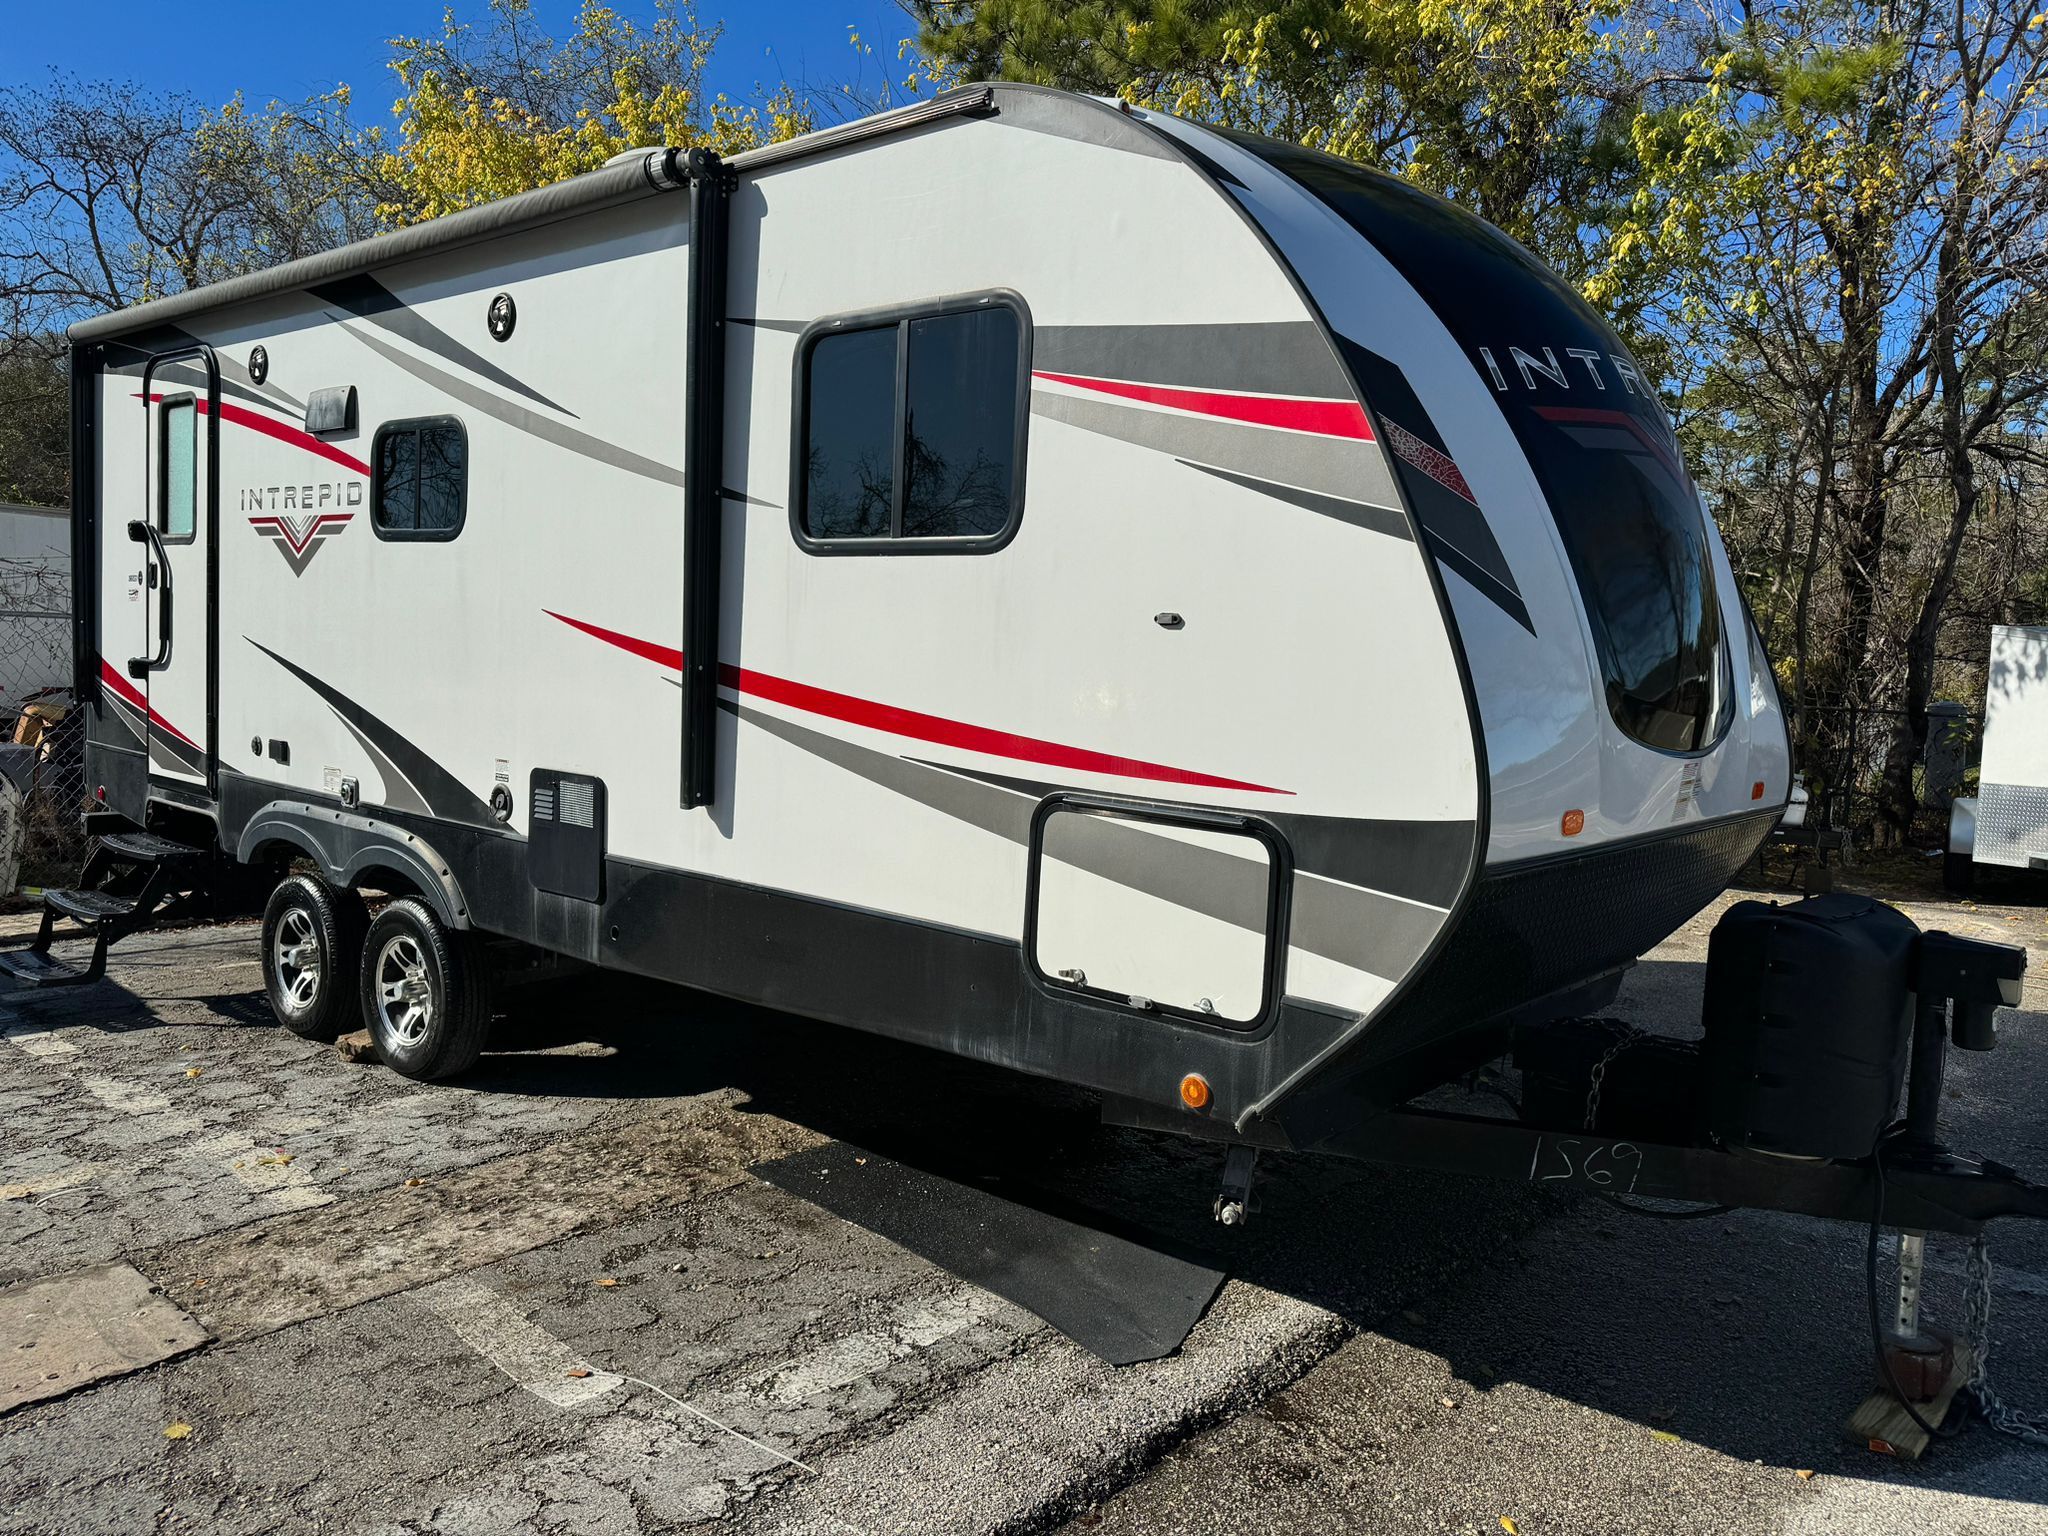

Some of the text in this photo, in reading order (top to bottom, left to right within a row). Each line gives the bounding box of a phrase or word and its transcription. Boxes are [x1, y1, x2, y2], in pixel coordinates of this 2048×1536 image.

[1479, 346, 1656, 402] INTR
[240, 481, 362, 511] INTREPID
[1529, 1136, 1643, 1193] 1569
